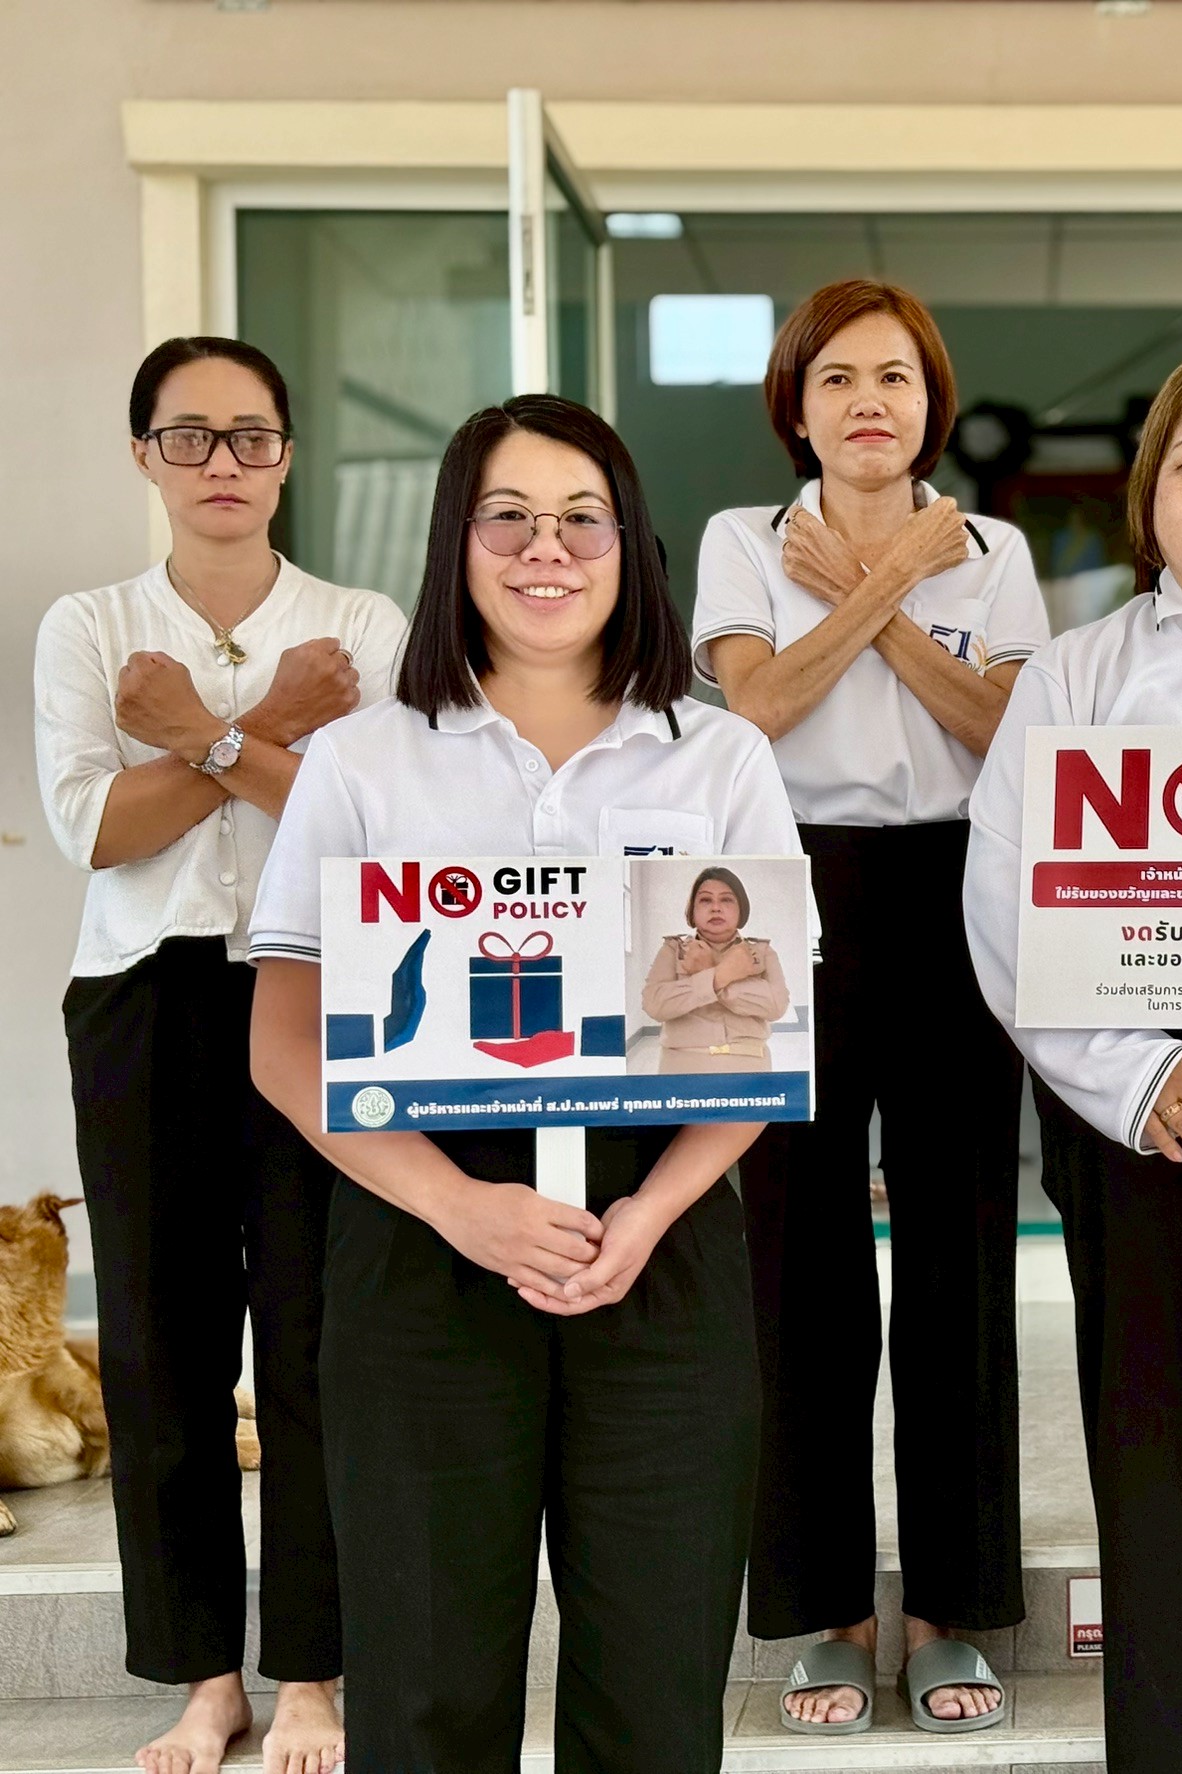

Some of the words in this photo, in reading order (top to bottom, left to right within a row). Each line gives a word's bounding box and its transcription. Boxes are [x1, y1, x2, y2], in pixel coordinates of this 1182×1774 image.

[492, 866, 588, 896] GIFT
[492, 901, 588, 921] POLICY
[406, 1095, 544, 1119] ผู้บริหารและเจ้าหน้าที่
[622, 1097, 663, 1114] ทุกคน
[1076, 1643, 1103, 1652] PLEASE
